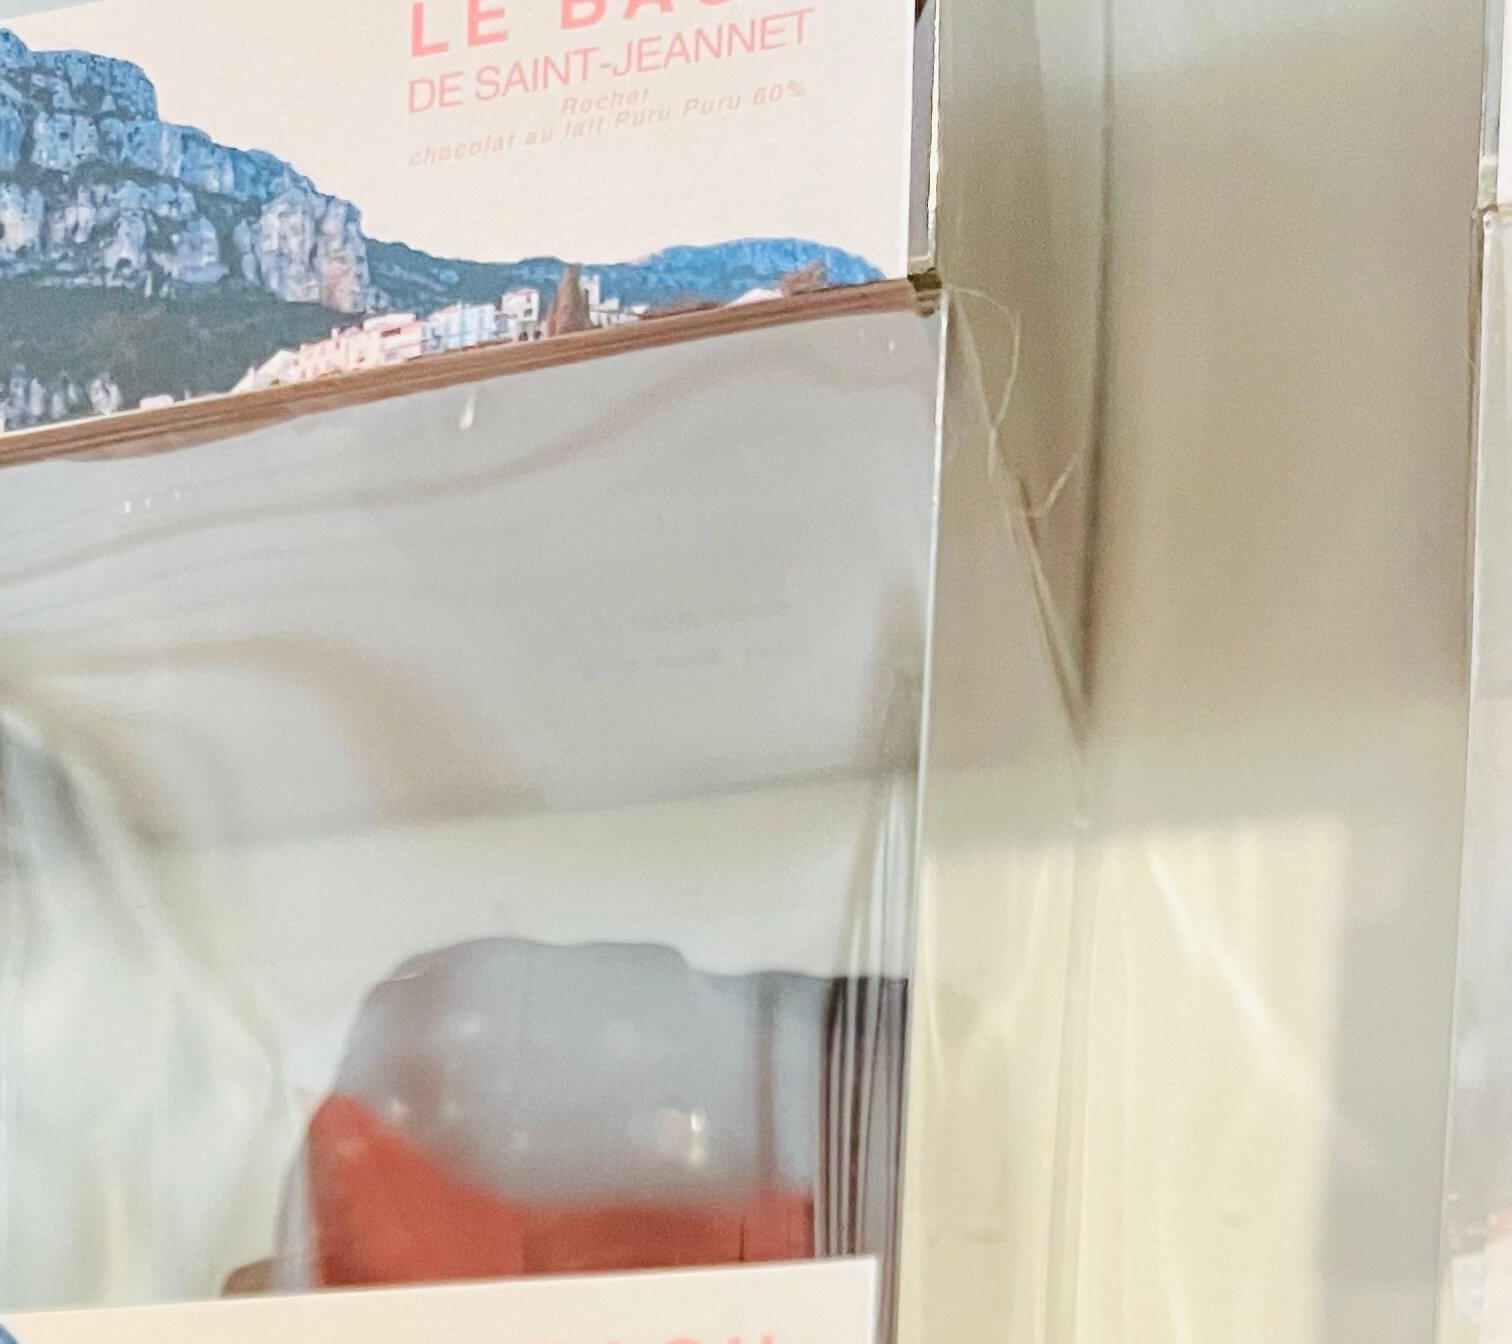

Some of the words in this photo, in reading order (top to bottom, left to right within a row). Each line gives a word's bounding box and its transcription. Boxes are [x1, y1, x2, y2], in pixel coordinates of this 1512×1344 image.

[410, 0, 508, 57] LE
[408, 70, 463, 115] DE
[474, 7, 816, 102] SAINT-JEANNET
[559, 87, 650, 117] Rocher
[408, 131, 515, 168] chocolat
[524, 127, 554, 148] au
